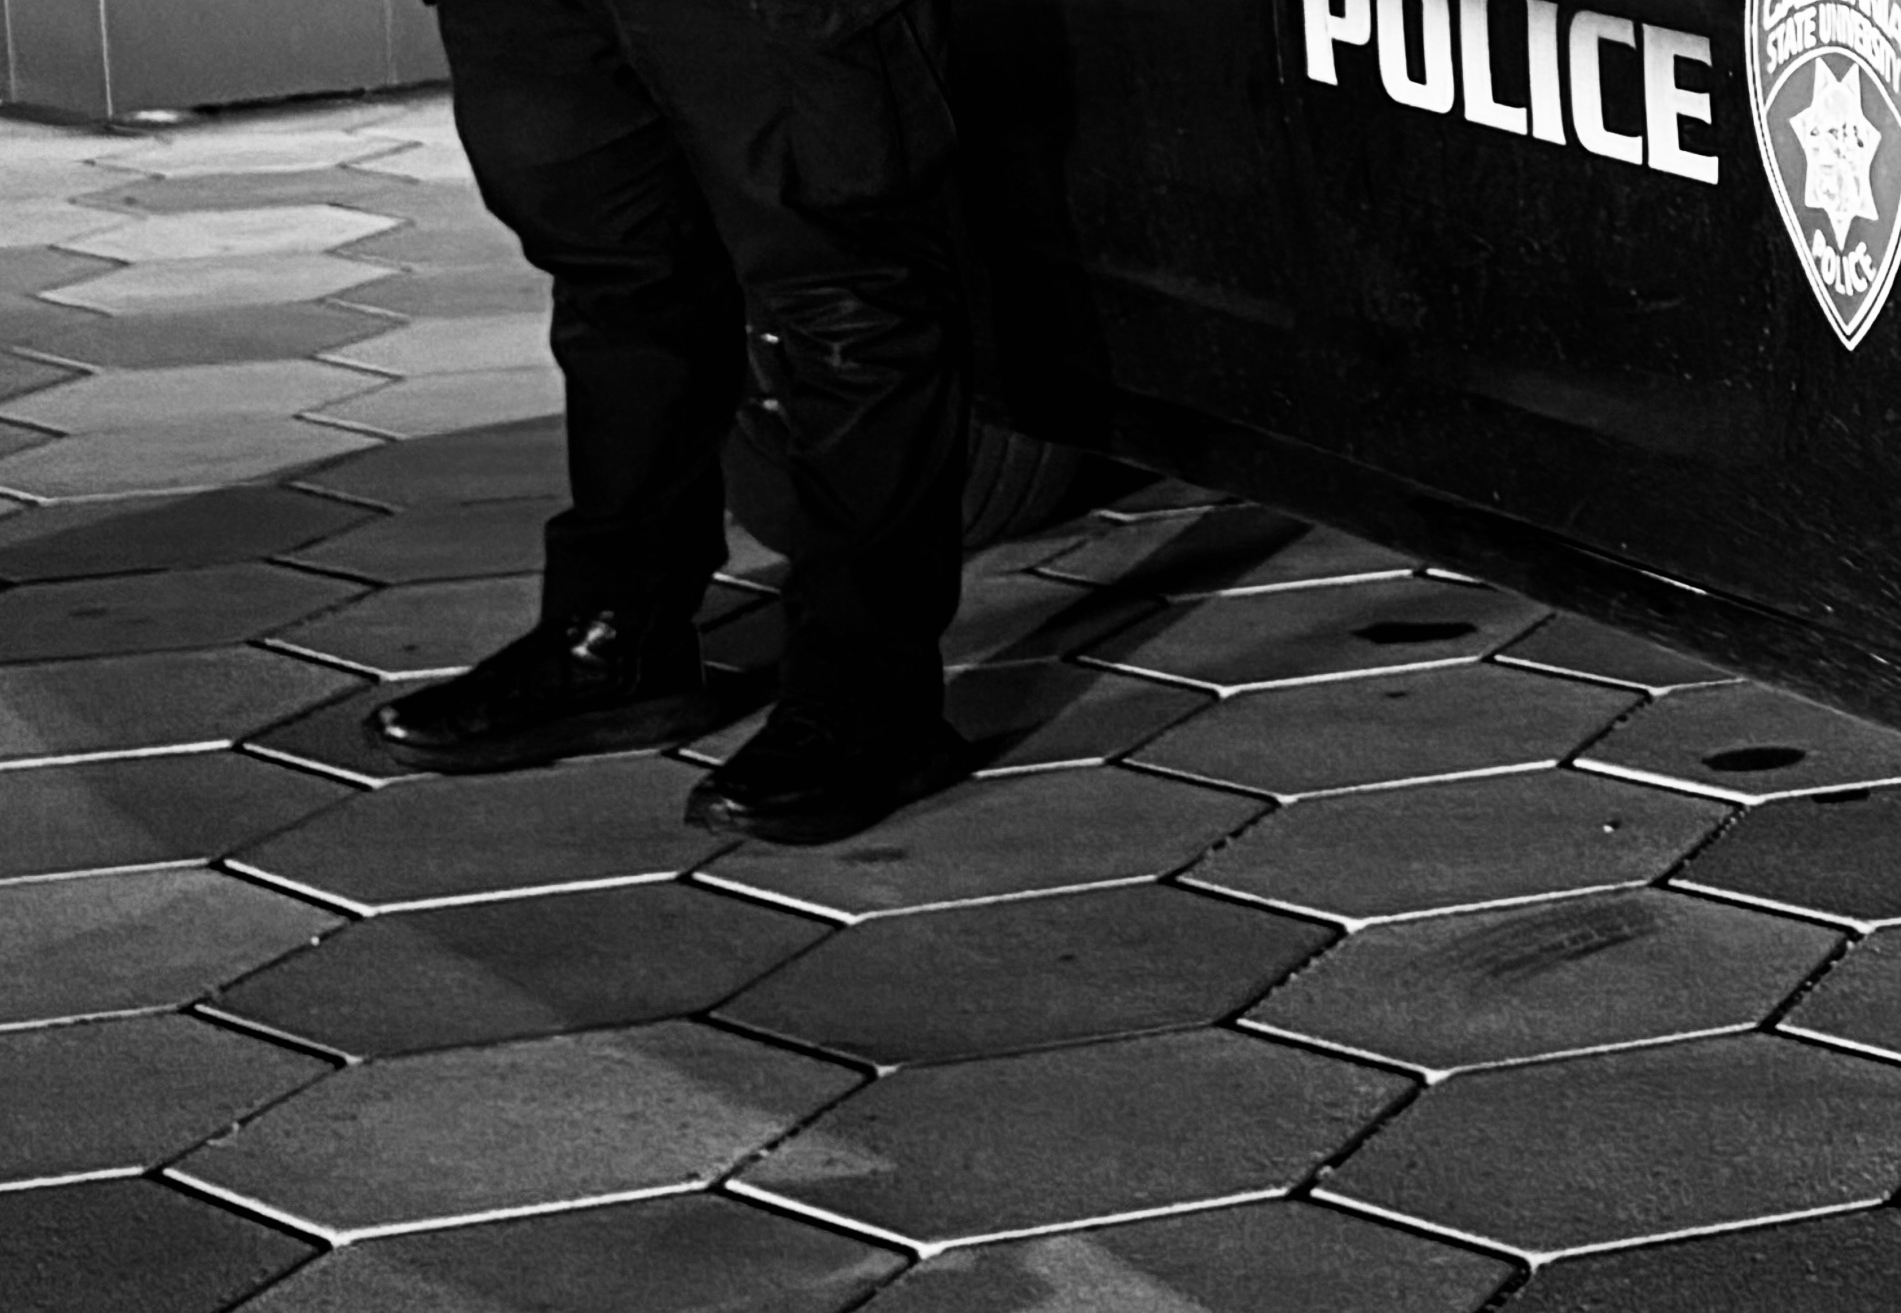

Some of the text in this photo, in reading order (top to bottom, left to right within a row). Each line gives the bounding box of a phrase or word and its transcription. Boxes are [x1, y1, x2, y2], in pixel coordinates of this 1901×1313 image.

[1766, 3, 1901, 94] STATE UNIVERSITY
[1811, 229, 1876, 296] POLICE
